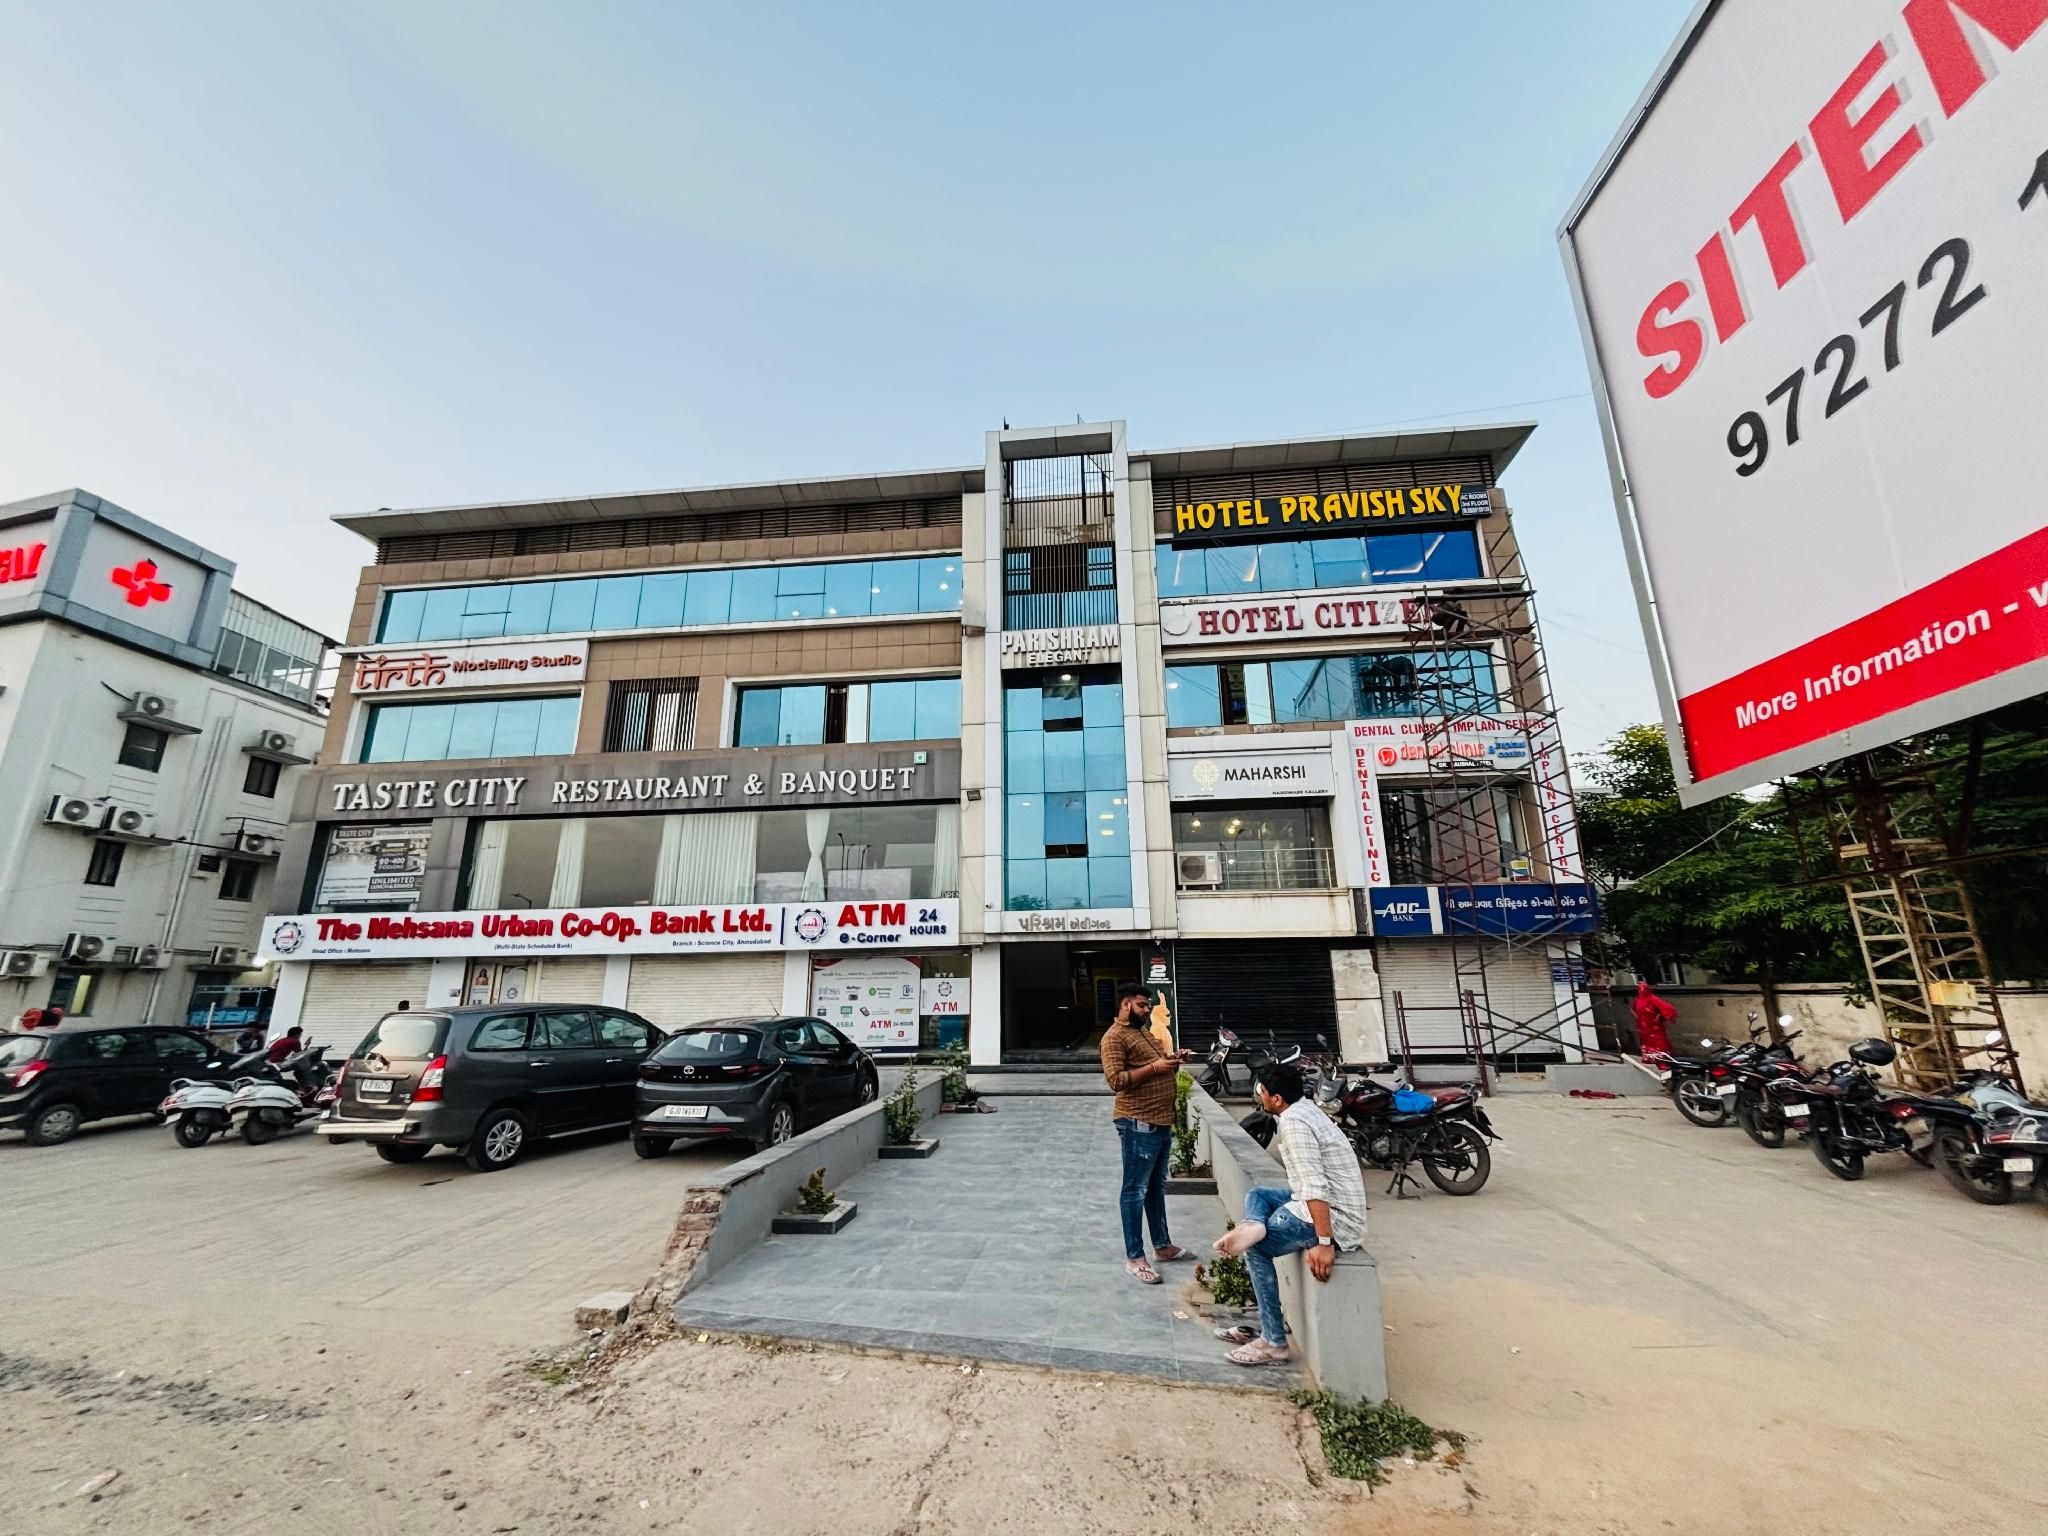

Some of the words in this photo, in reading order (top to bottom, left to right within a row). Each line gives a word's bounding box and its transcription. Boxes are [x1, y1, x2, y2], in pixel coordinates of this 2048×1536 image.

[1727, 236, 1990, 478] 97272
[1176, 499, 1269, 534] HOTEL
[1280, 489, 1406, 524] PRAVISH
[1411, 484, 1461, 515] SKY
[1198, 605, 1303, 636] HOTEL
[1001, 625, 1118, 654] PARISHRAM
[452, 658, 528, 674] Modelling
[530, 654, 581, 668] Studio
[1028, 649, 1091, 666] ELEGANT
[1735, 689, 1798, 729] More
[1803, 608, 1991, 702] Information
[1354, 724, 1395, 737] DENTAL
[1453, 720, 1500, 733] IMPLANT
[1400, 741, 1444, 760] denal
[1224, 765, 1306, 781] MAHARSHI
[1355, 748, 1371, 812] DENTAL
[332, 780, 437, 811] TASTE
[443, 776, 526, 808] CITY
[551, 774, 729, 803] RESTAURANT
[742, 772, 765, 796] &
[779, 766, 915, 796] BANQUET
[1363, 815, 1382, 882] CLINIC
[371, 876, 415, 885] UNLIMITED
[837, 903, 906, 927] ATM
[918, 908, 938, 922] 24
[1383, 902, 1420, 918] ADC
[1392, 914, 1414, 922] BANK
[317, 918, 362, 941] The
[367, 916, 475, 940] Mehsana
[481, 914, 554, 938] Urban
[560, 912, 642, 943] Co-Op.
[650, 910, 716, 935] Bank
[722, 908, 772, 933] Ltd.
[909, 924, 947, 936] HOURS
[736, 938, 772, 946] Ahmedabad
[932, 1001, 958, 1012] ATM
[870, 1020, 892, 1029] ATM
